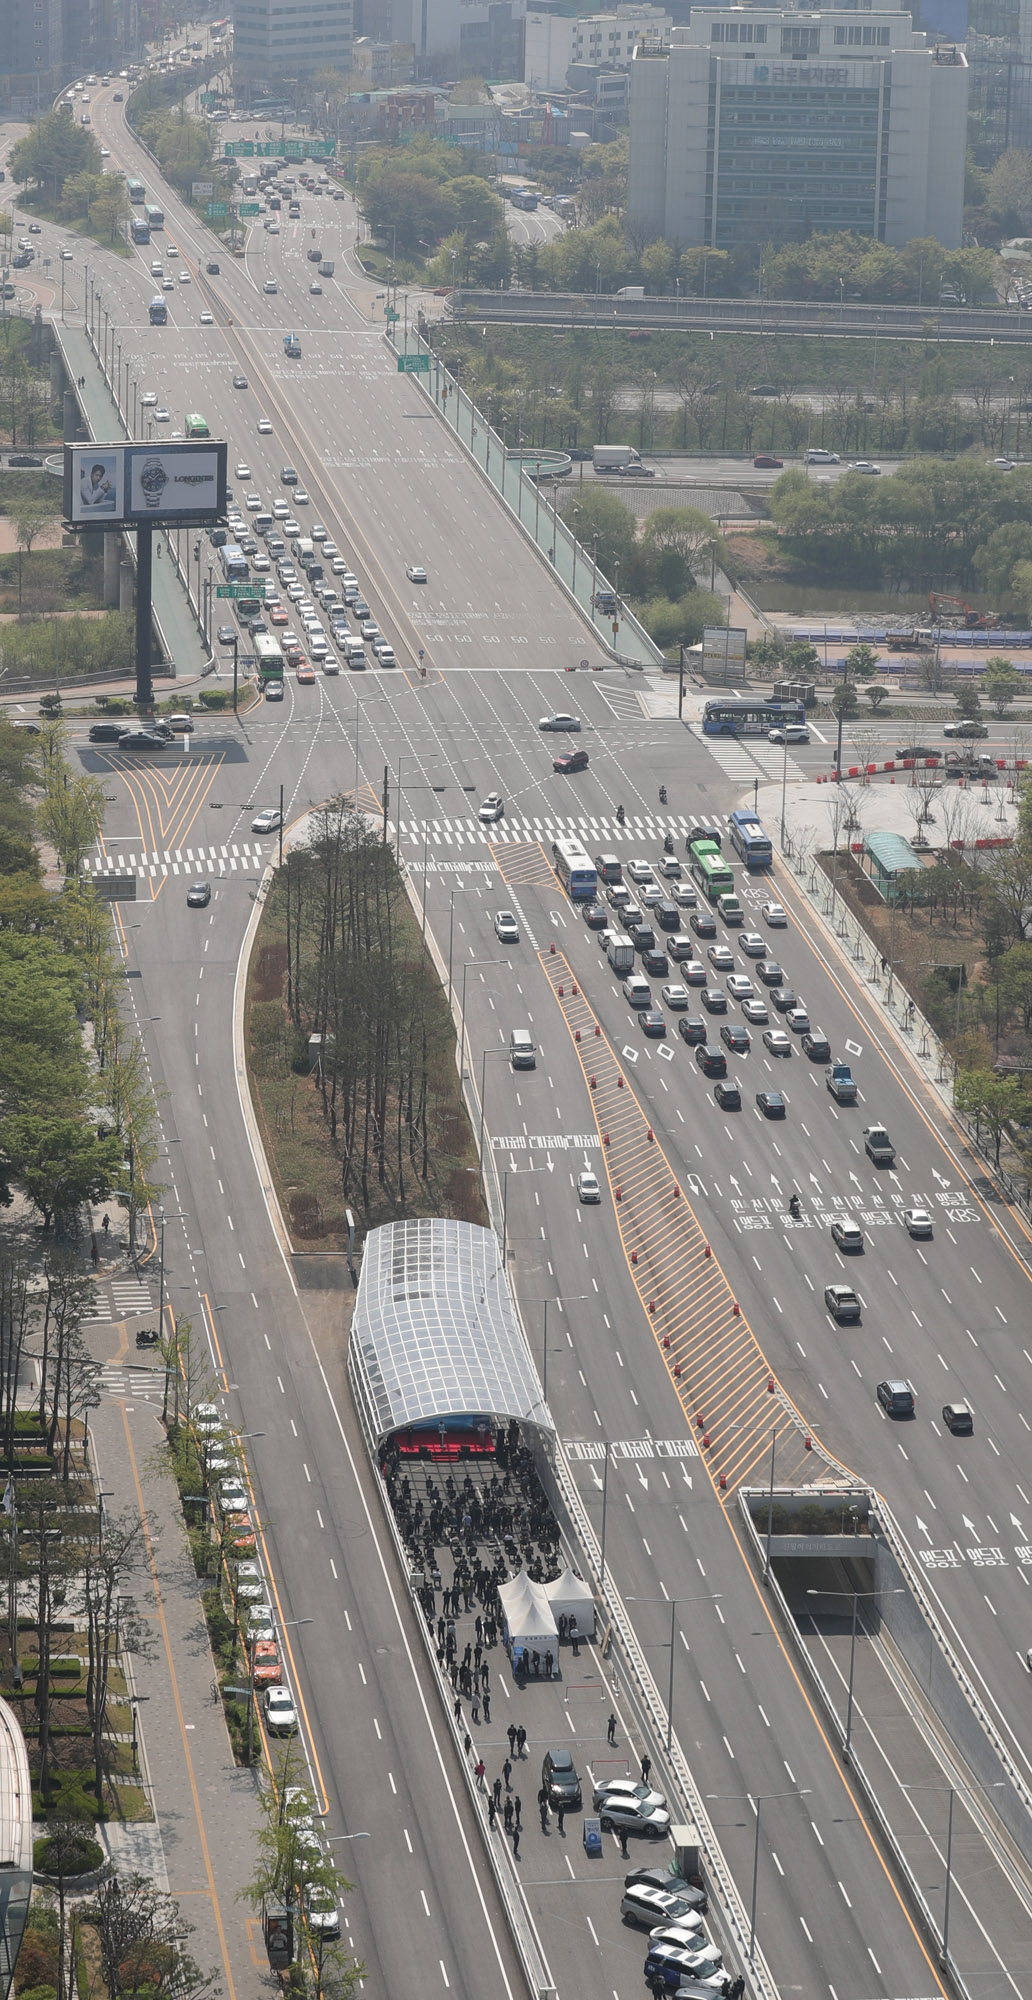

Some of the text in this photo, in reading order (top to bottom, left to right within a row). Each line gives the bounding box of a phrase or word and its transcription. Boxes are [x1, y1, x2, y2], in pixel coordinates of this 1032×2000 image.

[772, 67, 848, 84] 근로복지공단
[425, 634, 444, 642] 50
[454, 634, 472, 643] 50
[482, 635, 500, 643] 50
[510, 635, 528, 644] 50
[740, 888, 770, 899] KBS
[731, 1198, 765, 1213] 인천
[811, 1196, 846, 1210] 인천
[850, 1194, 886, 1209] 인천
[891, 1193, 926, 1208] 인천
[935, 1191, 971, 1206] 영등포
[739, 1216, 774, 1230] 영등포
[860, 1211, 896, 1225] 영등포
[946, 1209, 981, 1223] KBS
[919, 1549, 962, 1568] 영등포
[966, 1547, 1009, 1566] 영등포
